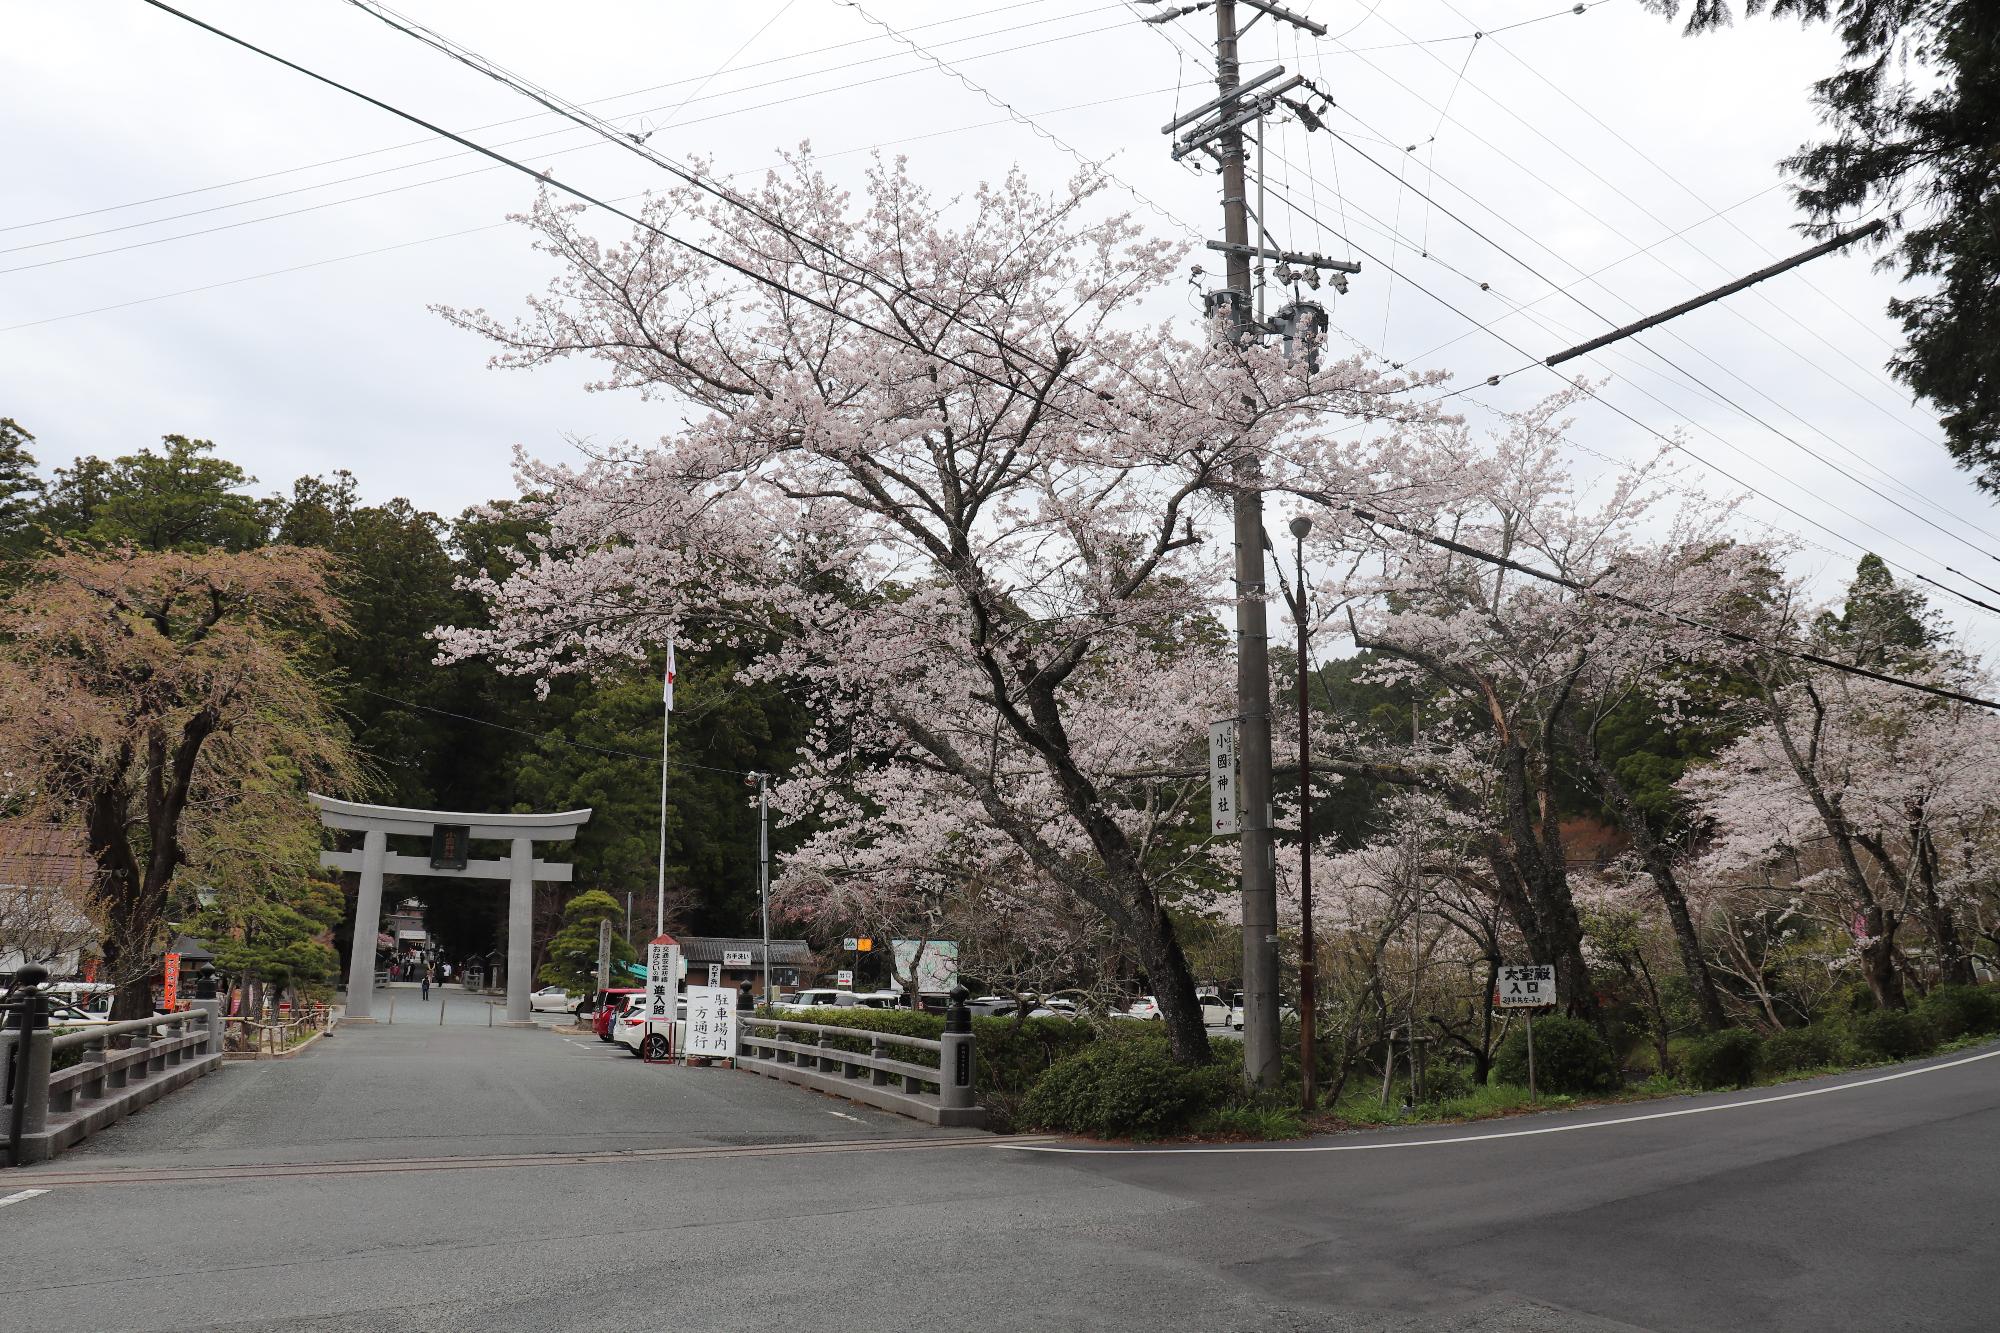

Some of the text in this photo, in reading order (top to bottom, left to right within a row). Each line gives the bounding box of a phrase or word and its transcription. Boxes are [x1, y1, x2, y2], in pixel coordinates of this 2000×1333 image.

[1216, 733, 1229, 812] 小國神社
[1505, 967, 1550, 981] 大宝殿
[1510, 982, 1539, 994] 入口
[653, 985, 665, 1015] 進入路
[694, 995, 709, 1049] 一方通行
[714, 994, 729, 1050] 駐車場内
